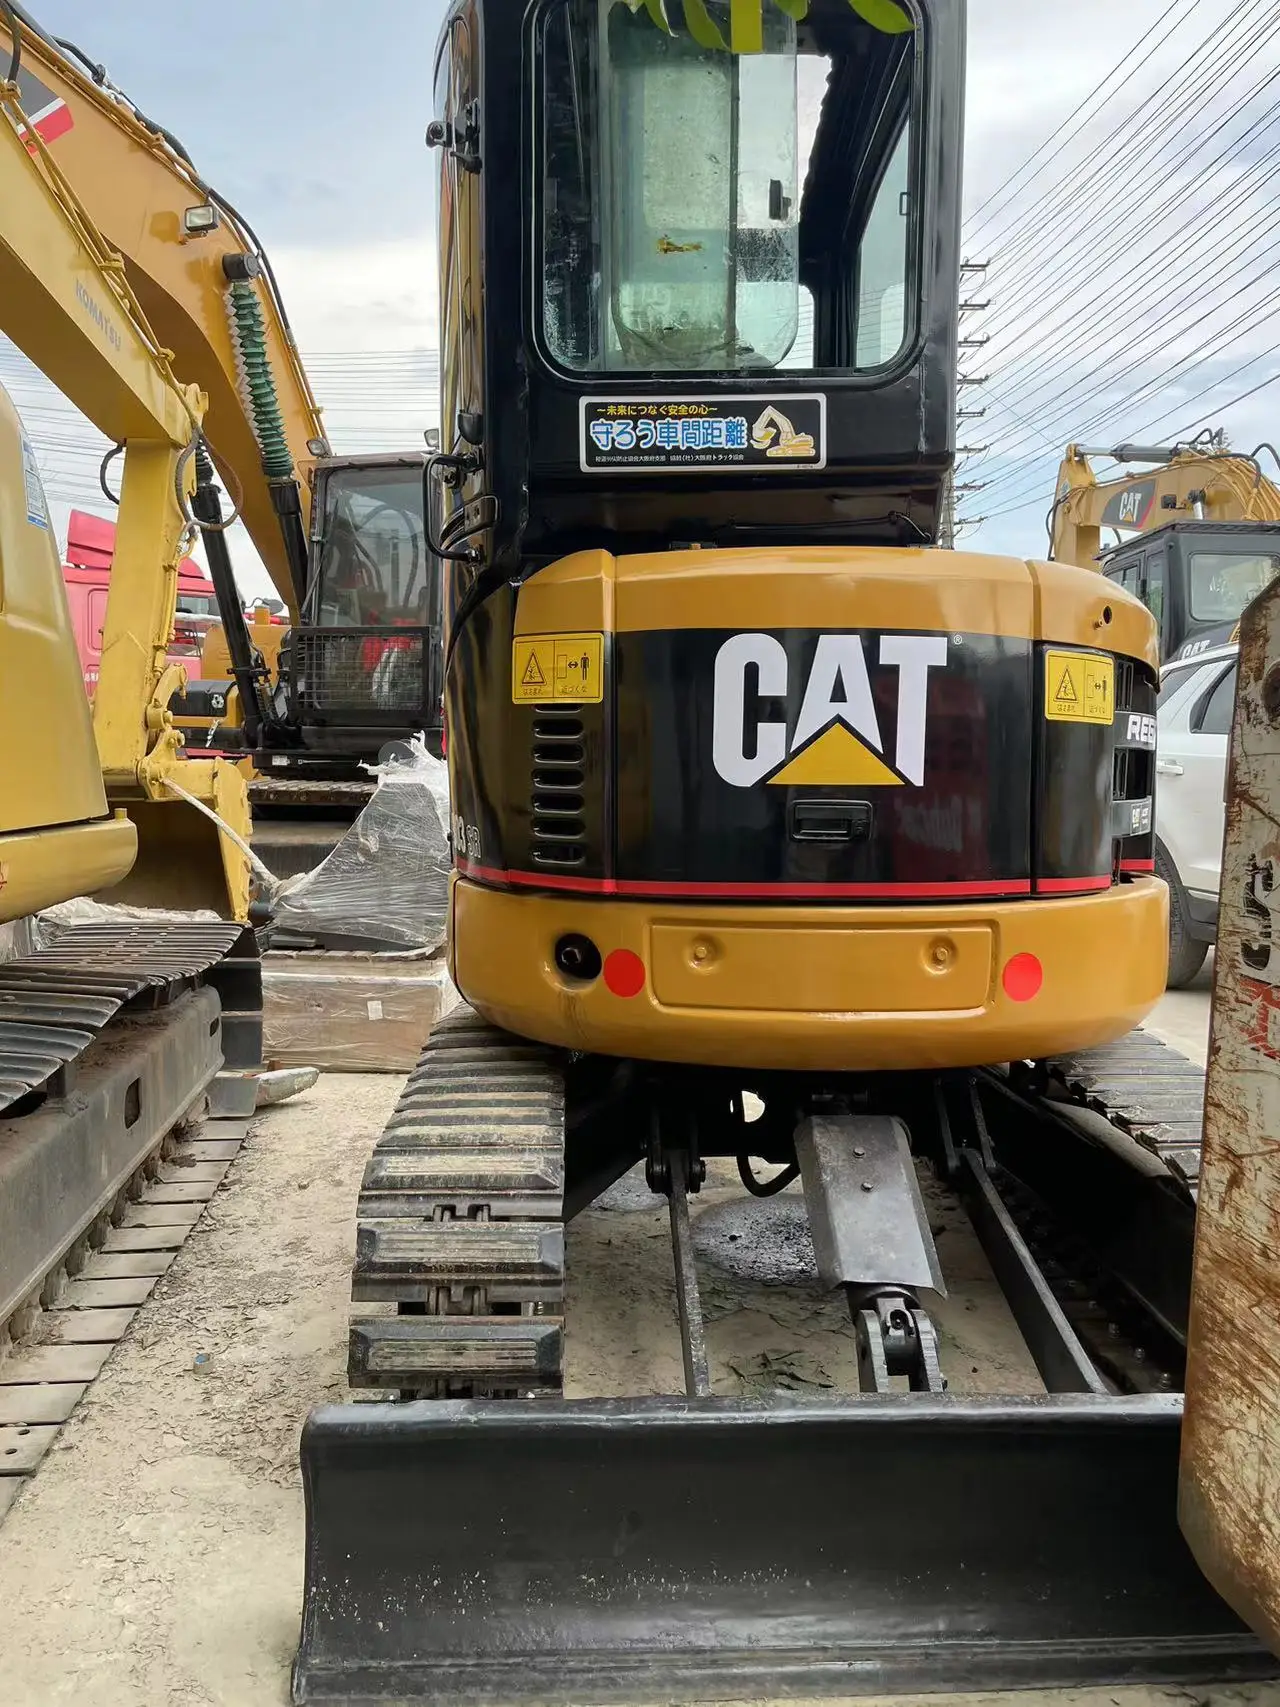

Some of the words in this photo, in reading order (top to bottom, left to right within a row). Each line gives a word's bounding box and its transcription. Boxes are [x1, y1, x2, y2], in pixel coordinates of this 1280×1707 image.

[74, 277, 121, 352] KOMATSU
[590, 416, 748, 451] 守ろう車間距離
[1119, 492, 1142, 523] CAT
[712, 633, 948, 787] CAT
